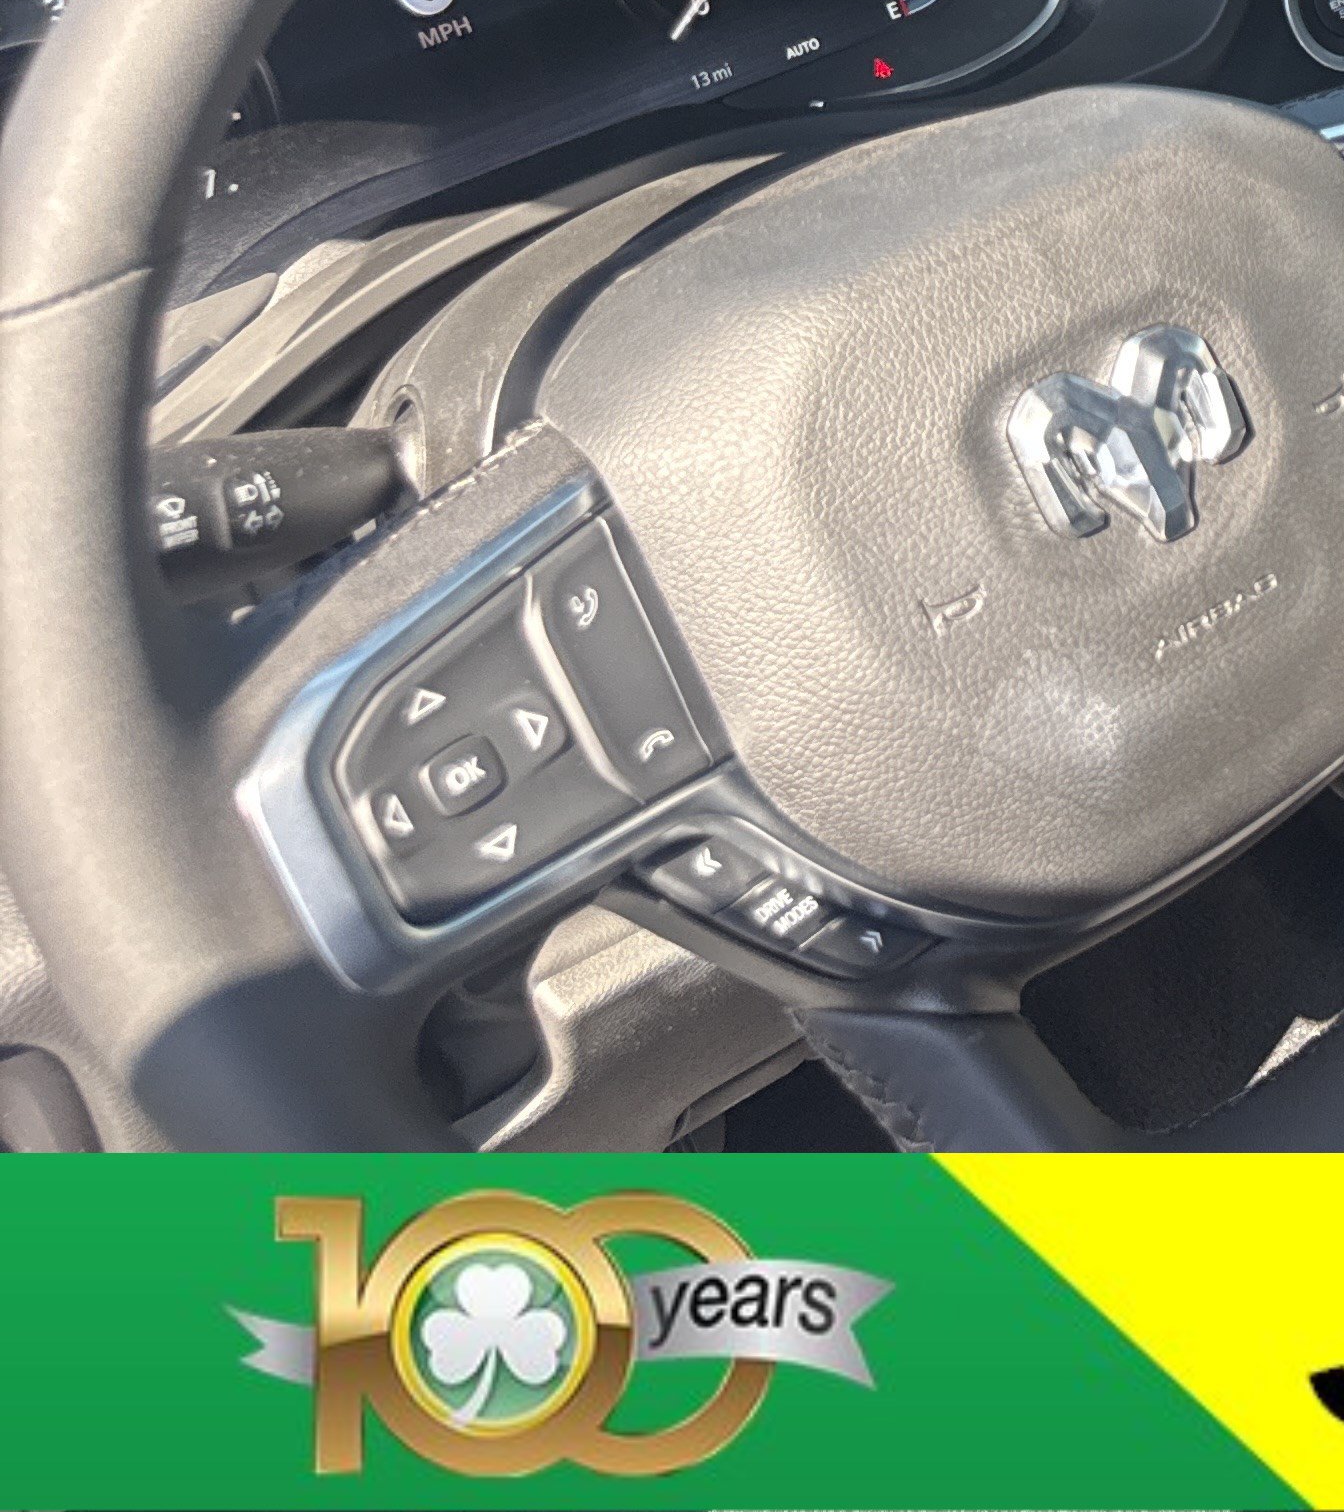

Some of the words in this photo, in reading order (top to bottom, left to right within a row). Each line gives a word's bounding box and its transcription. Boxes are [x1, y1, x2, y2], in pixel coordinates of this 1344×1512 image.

[885, 0, 903, 20] E
[416, 14, 474, 51] MPH
[786, 37, 821, 61] AUTO
[444, 757, 488, 793] OK
[754, 887, 794, 924] DRIVE
[772, 895, 820, 936] MODES
